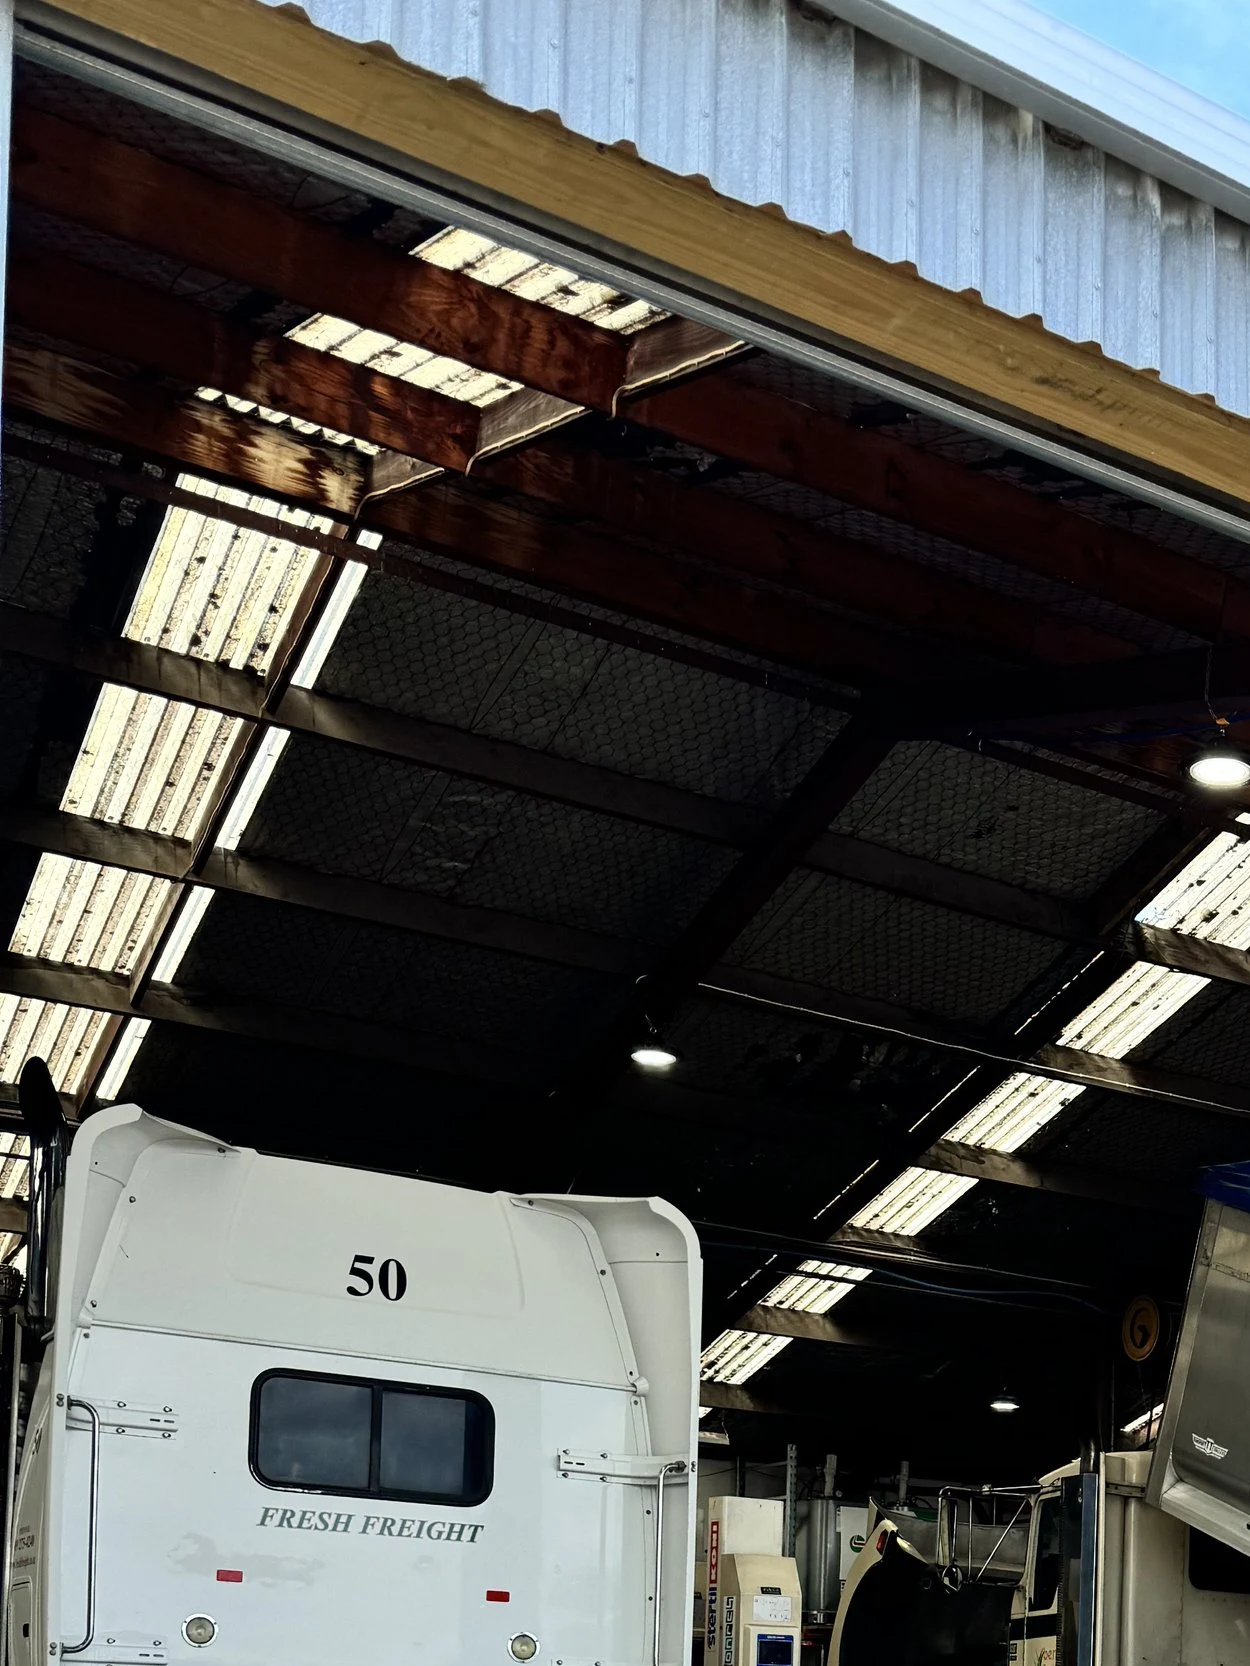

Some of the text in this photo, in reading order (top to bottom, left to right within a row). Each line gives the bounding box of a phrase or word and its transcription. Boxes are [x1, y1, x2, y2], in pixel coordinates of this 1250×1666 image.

[346, 1254, 407, 1301] 50
[256, 1506, 484, 1544] FRESH FREIGHT
[710, 1523, 719, 1581] KONI
